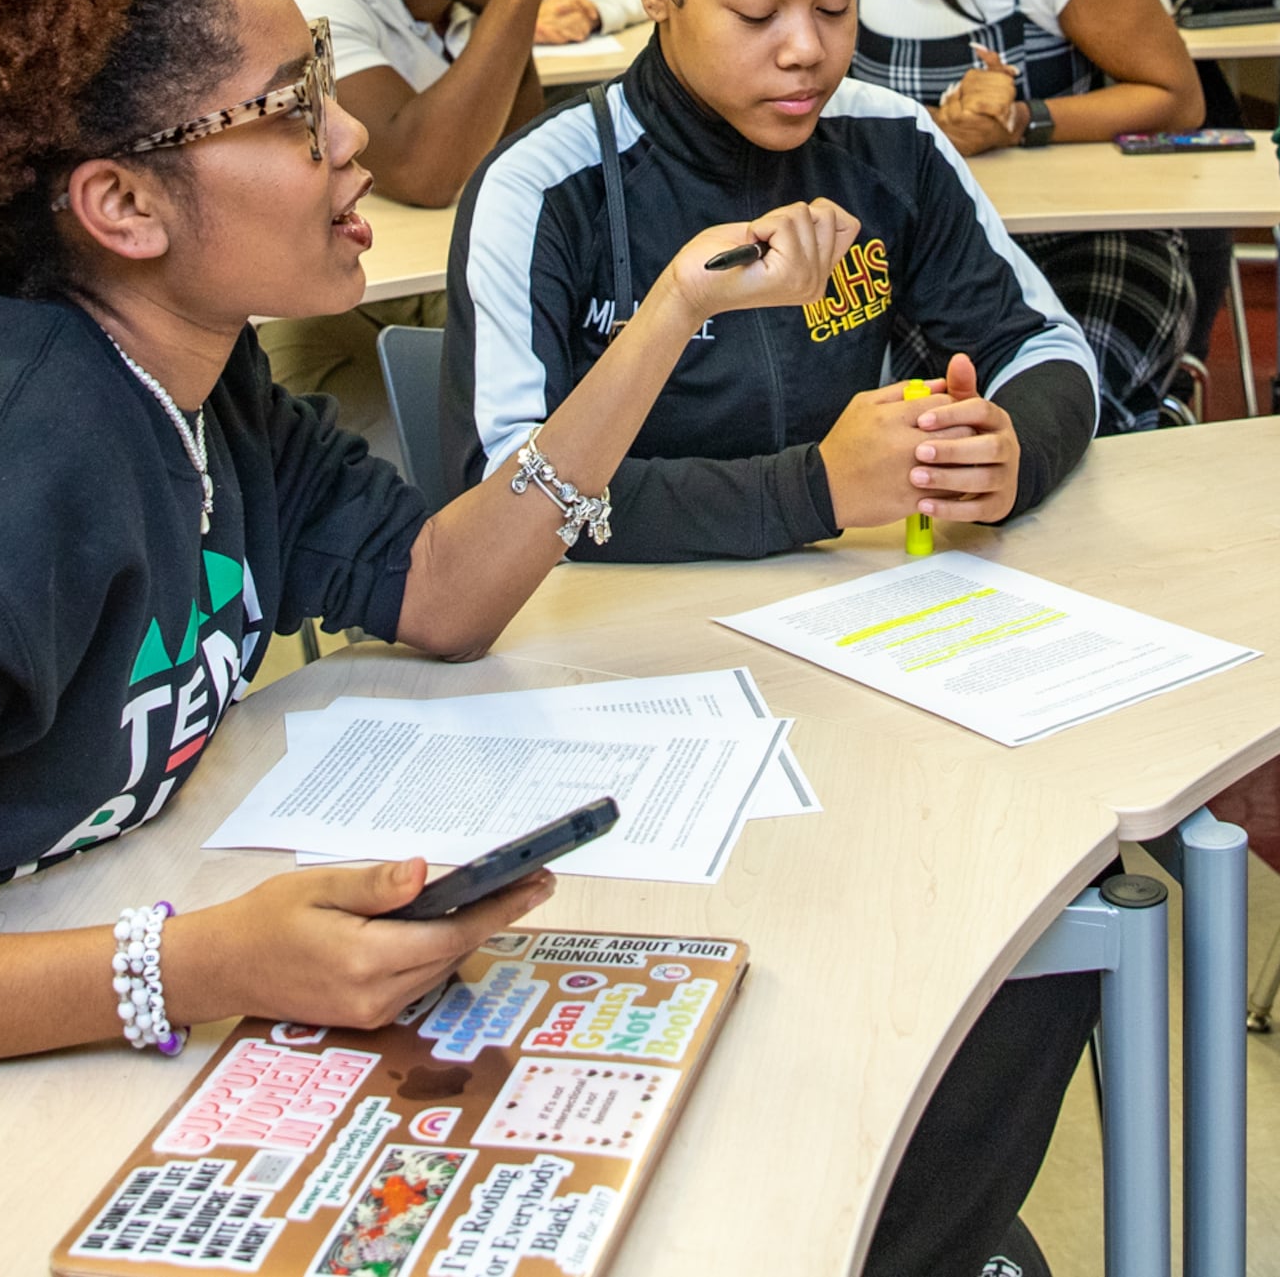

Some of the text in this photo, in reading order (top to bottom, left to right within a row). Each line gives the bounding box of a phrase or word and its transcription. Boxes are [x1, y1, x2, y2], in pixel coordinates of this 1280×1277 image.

[530, 947, 641, 967] PRONOUNS.
[538, 935, 730, 957] I CARE ABOUT YOUR
[430, 987, 475, 1033] KEEP
[445, 966, 522, 1055] ABORTION
[482, 984, 537, 1040] LEGAL
[531, 1004, 587, 1048] Ban
[570, 985, 641, 1051] Guns,
[606, 1008, 657, 1052] Not
[643, 982, 711, 1057] Books.
[163, 1041, 282, 1150] SUPPORT
[218, 1053, 323, 1141] WOMEN
[269, 1051, 373, 1149] IN STEM
[551, 1085, 565, 1101] not
[584, 1091, 599, 1105] not
[591, 1088, 619, 1126] feminism
[298, 1099, 383, 1215] never let anybody make
[324, 1116, 394, 1202] you feel ordinary
[80, 1170, 161, 1250] DO SOMETHING
[110, 1163, 194, 1252] WITH YOUR LIFE
[139, 1161, 226, 1254] THAT WILL MAKE
[171, 1189, 236, 1258] A MEDIOCRE
[199, 1193, 264, 1259] WHITE MAN
[440, 1169, 524, 1272] I'm Rooting
[475, 1158, 565, 1277] or Everybody
[529, 1197, 581, 1253] Black.
